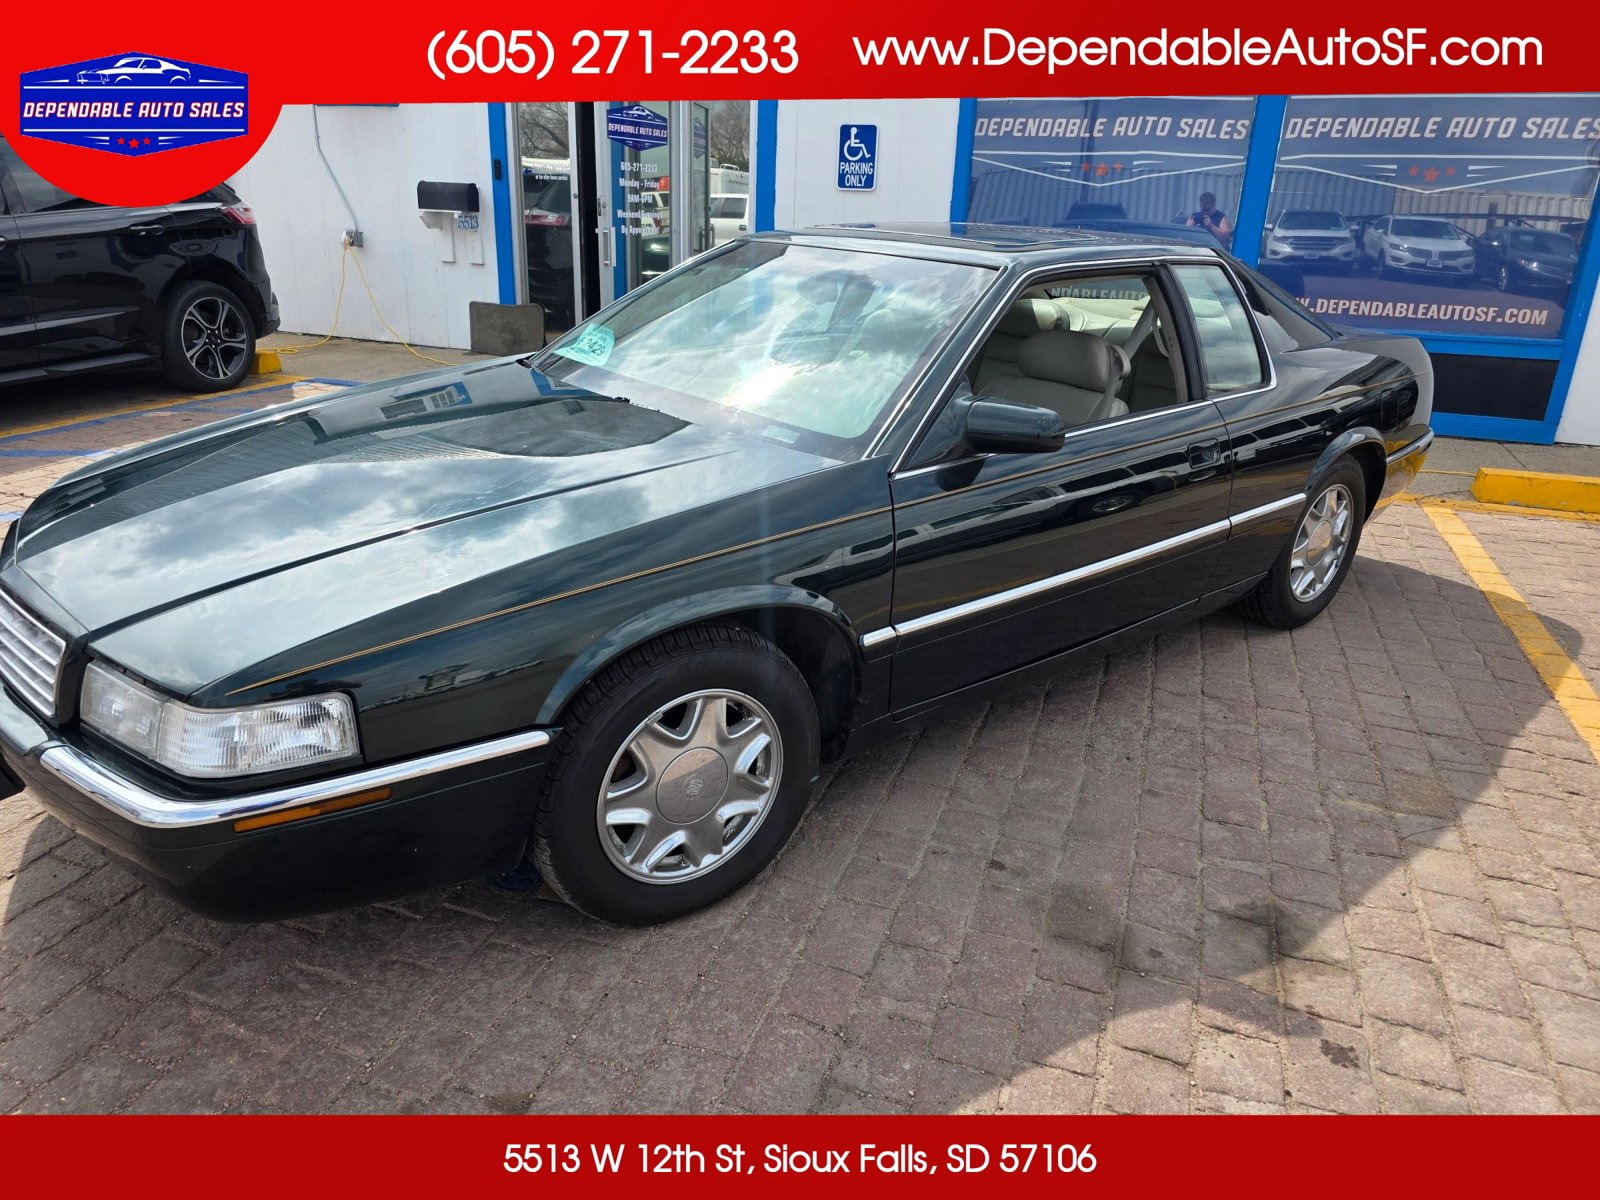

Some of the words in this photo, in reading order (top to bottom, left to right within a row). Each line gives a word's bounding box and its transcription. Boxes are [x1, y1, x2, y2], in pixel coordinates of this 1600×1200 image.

[608, 122, 639, 135] DEPENDABLE
[639, 127, 652, 137] AUTO
[652, 129, 668, 138] SALES
[974, 117, 1107, 138] DEPENDABLE
[1112, 116, 1171, 137] AUTO
[1176, 118, 1250, 140] SALES
[1285, 117, 1442, 140] DEPENDABLE
[1446, 117, 1515, 140] AUTO
[1521, 117, 1600, 140] SALES
[620, 161, 658, 173] 605-271-2233
[840, 161, 874, 175] PARKING
[619, 178, 640, 189] Monday
[644, 179, 660, 190] Friday
[844, 174, 867, 187] ONLY
[458, 214, 479, 230] 5513
